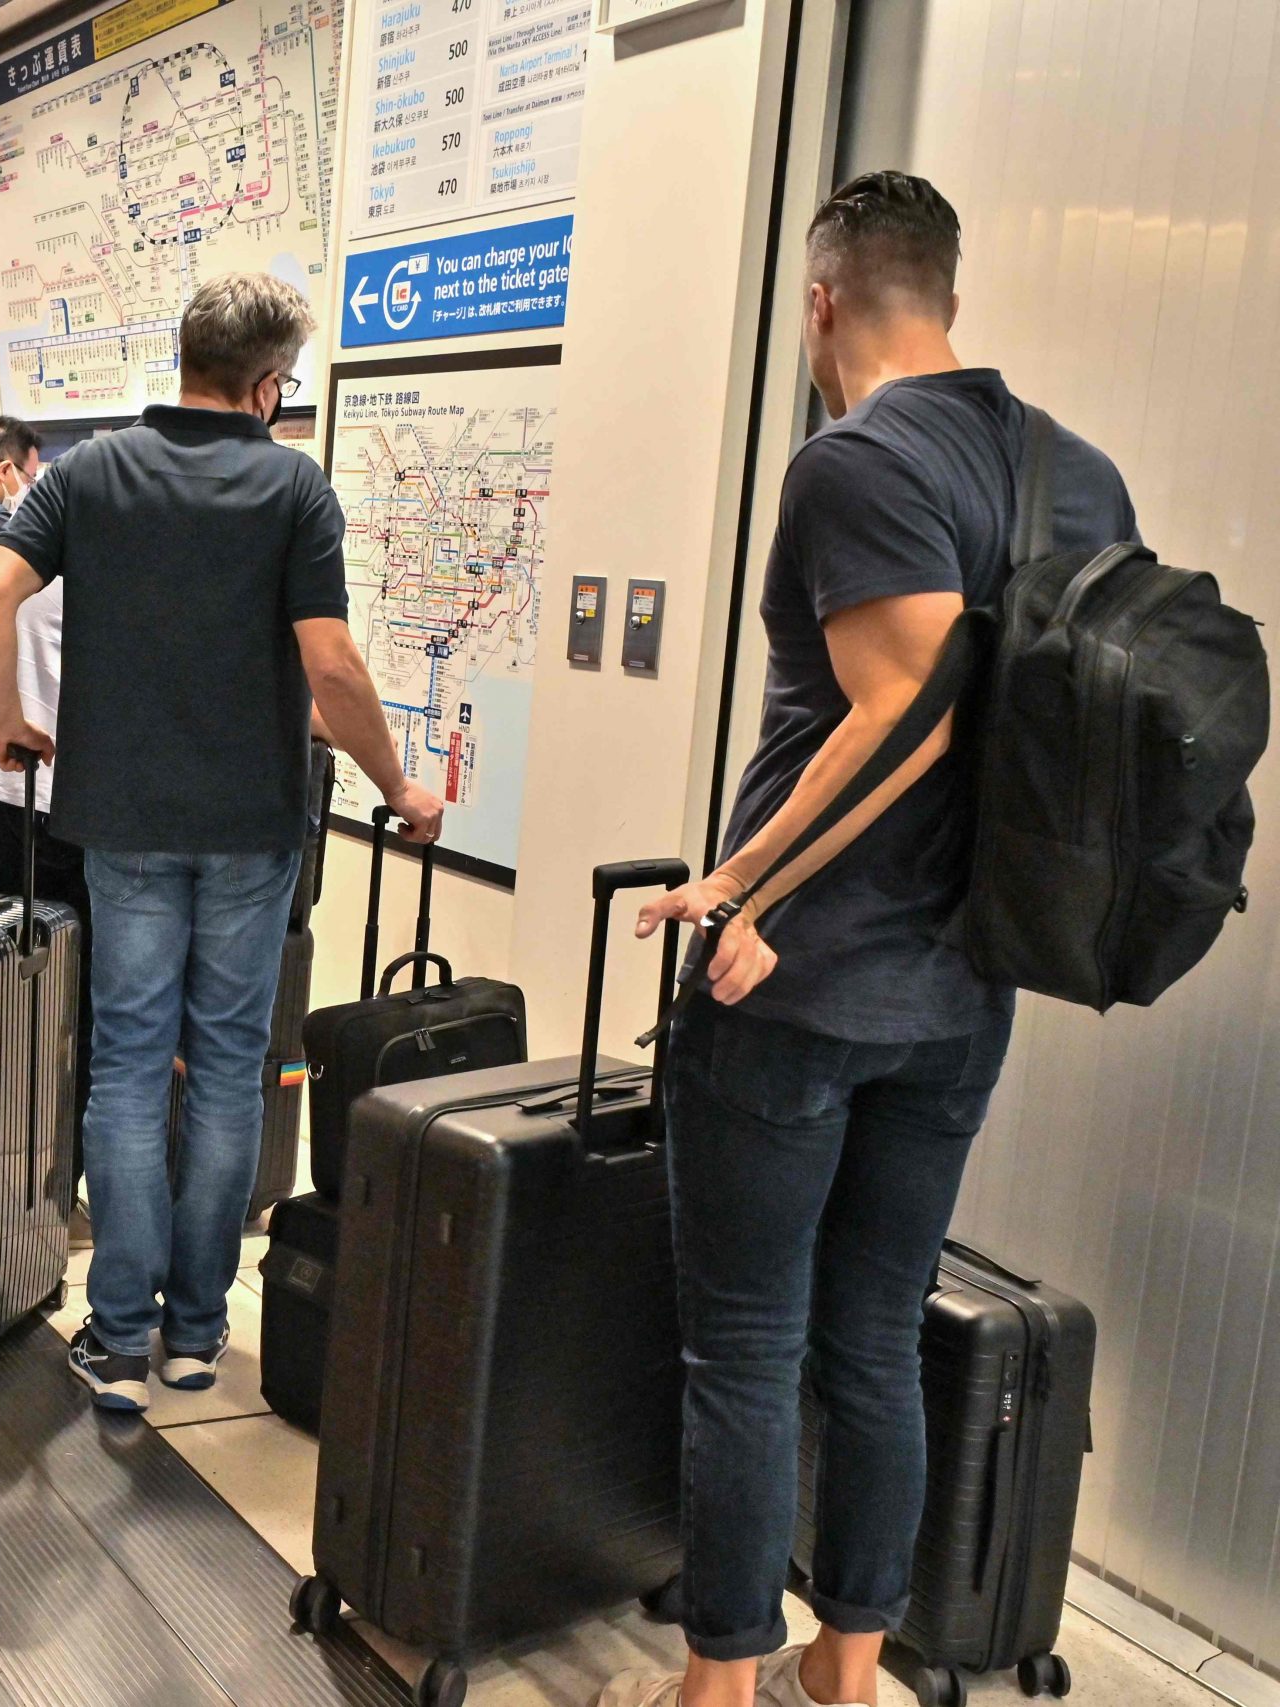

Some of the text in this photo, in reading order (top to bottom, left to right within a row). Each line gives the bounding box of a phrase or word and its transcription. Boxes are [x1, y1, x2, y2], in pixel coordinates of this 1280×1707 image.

[381, 3, 421, 29] Harajuku
[533, 32, 550, 43] ACCESS
[7, 33, 82, 87] きっぷ運賃表
[448, 40, 468, 60] 500
[378, 48, 416, 73] Shinjuku
[444, 86, 464, 107] 500
[374, 113, 404, 133] 新大久保
[494, 121, 533, 144] Roppongi
[372, 137, 416, 159] Ikebukuro
[442, 132, 461, 152] 570
[492, 145, 514, 158] 六本木
[370, 182, 396, 203] Tōkyō
[438, 178, 458, 196] 470
[368, 204, 382, 219] 東京
[436, 256, 459, 275] You
[461, 254, 481, 272] can
[484, 246, 526, 269] charge
[528, 240, 560, 264] your
[434, 281, 460, 300] next
[462, 280, 475, 296] to
[478, 274, 498, 294] the
[501, 267, 536, 290] ticket
[395, 391, 420, 404] 路線図
[400, 406, 426, 419] Subway
[428, 406, 447, 416] Route
[449, 405, 465, 416] Map
[458, 726, 470, 734] HND
